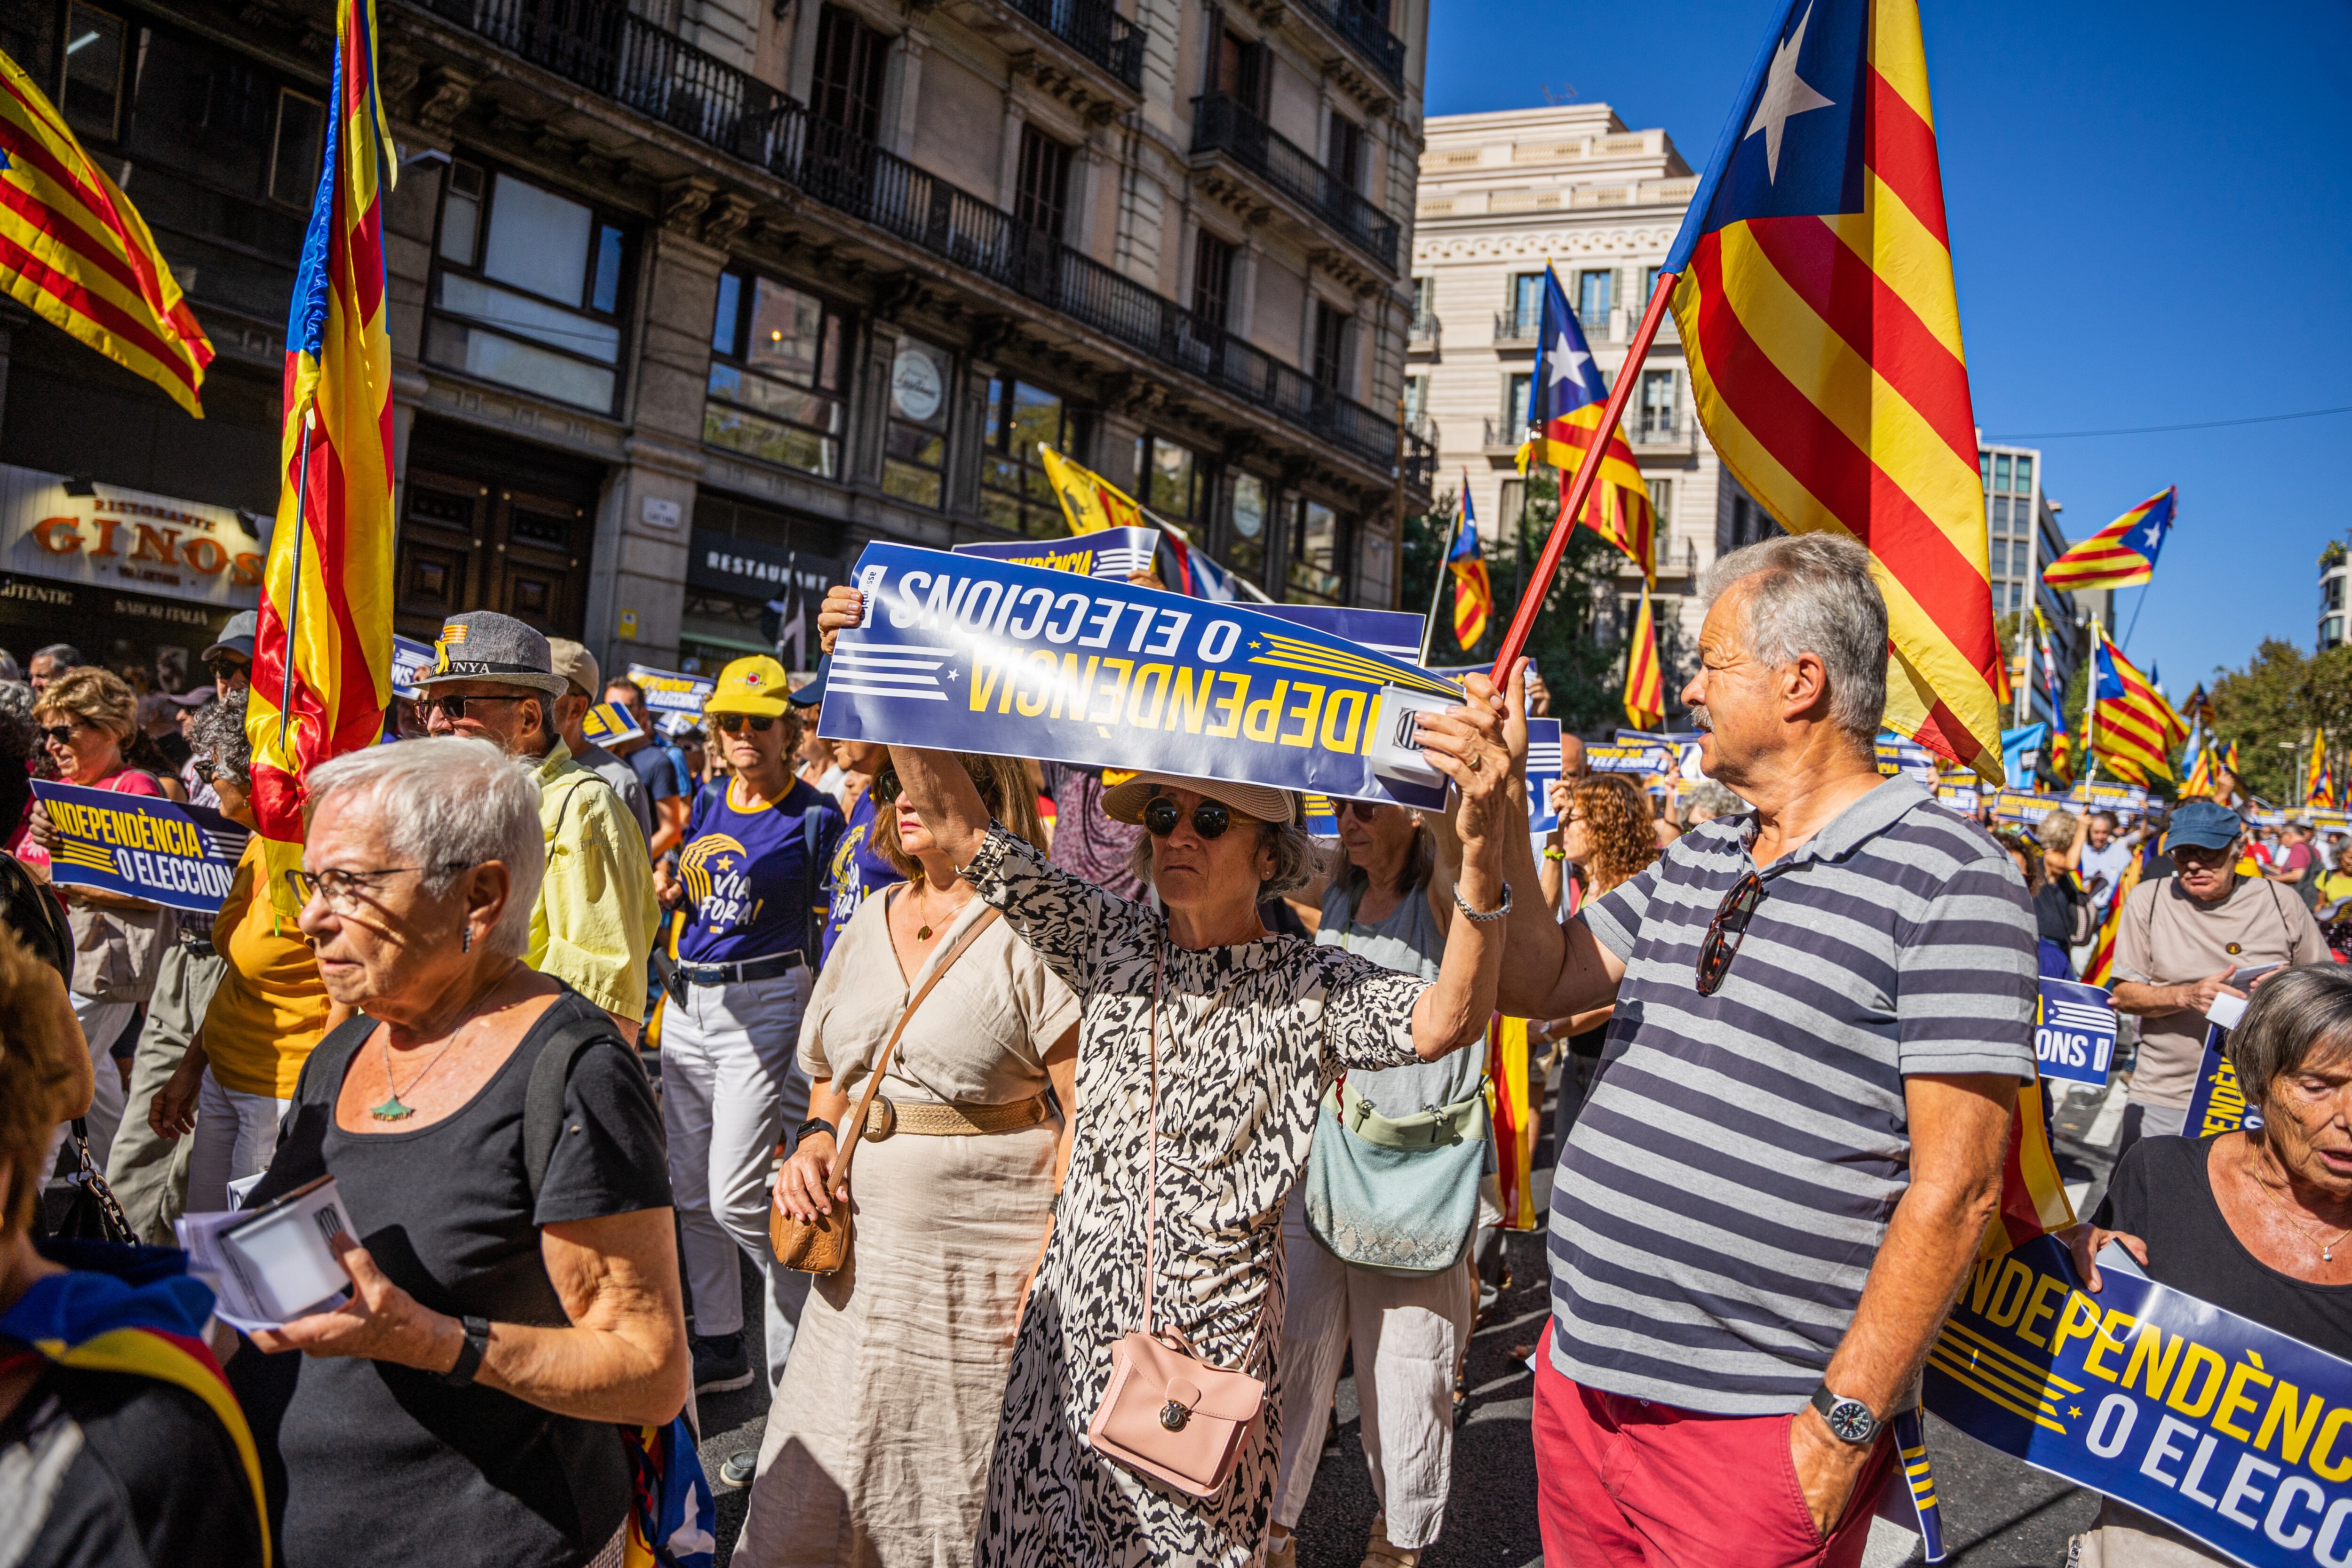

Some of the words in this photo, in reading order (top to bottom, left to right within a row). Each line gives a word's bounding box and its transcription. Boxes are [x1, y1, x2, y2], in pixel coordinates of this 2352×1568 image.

[94, 500, 216, 532] RISTORANTE
[31, 516, 265, 586] GINOS
[889, 571, 1192, 656] ELECCIONS
[1198, 619, 1242, 663] O
[429, 662, 490, 677] TAUNYA
[45, 798, 204, 859] INDEPENDÈNCIA
[116, 848, 135, 883] O
[133, 850, 237, 899] ELECCION
[714, 869, 752, 900] VIA
[699, 895, 764, 926] FORA!
[2035, 1028, 2089, 1067] ONS
[1955, 1254, 2352, 1482] NDEPENDÈNC
[2086, 1393, 2138, 1458] O
